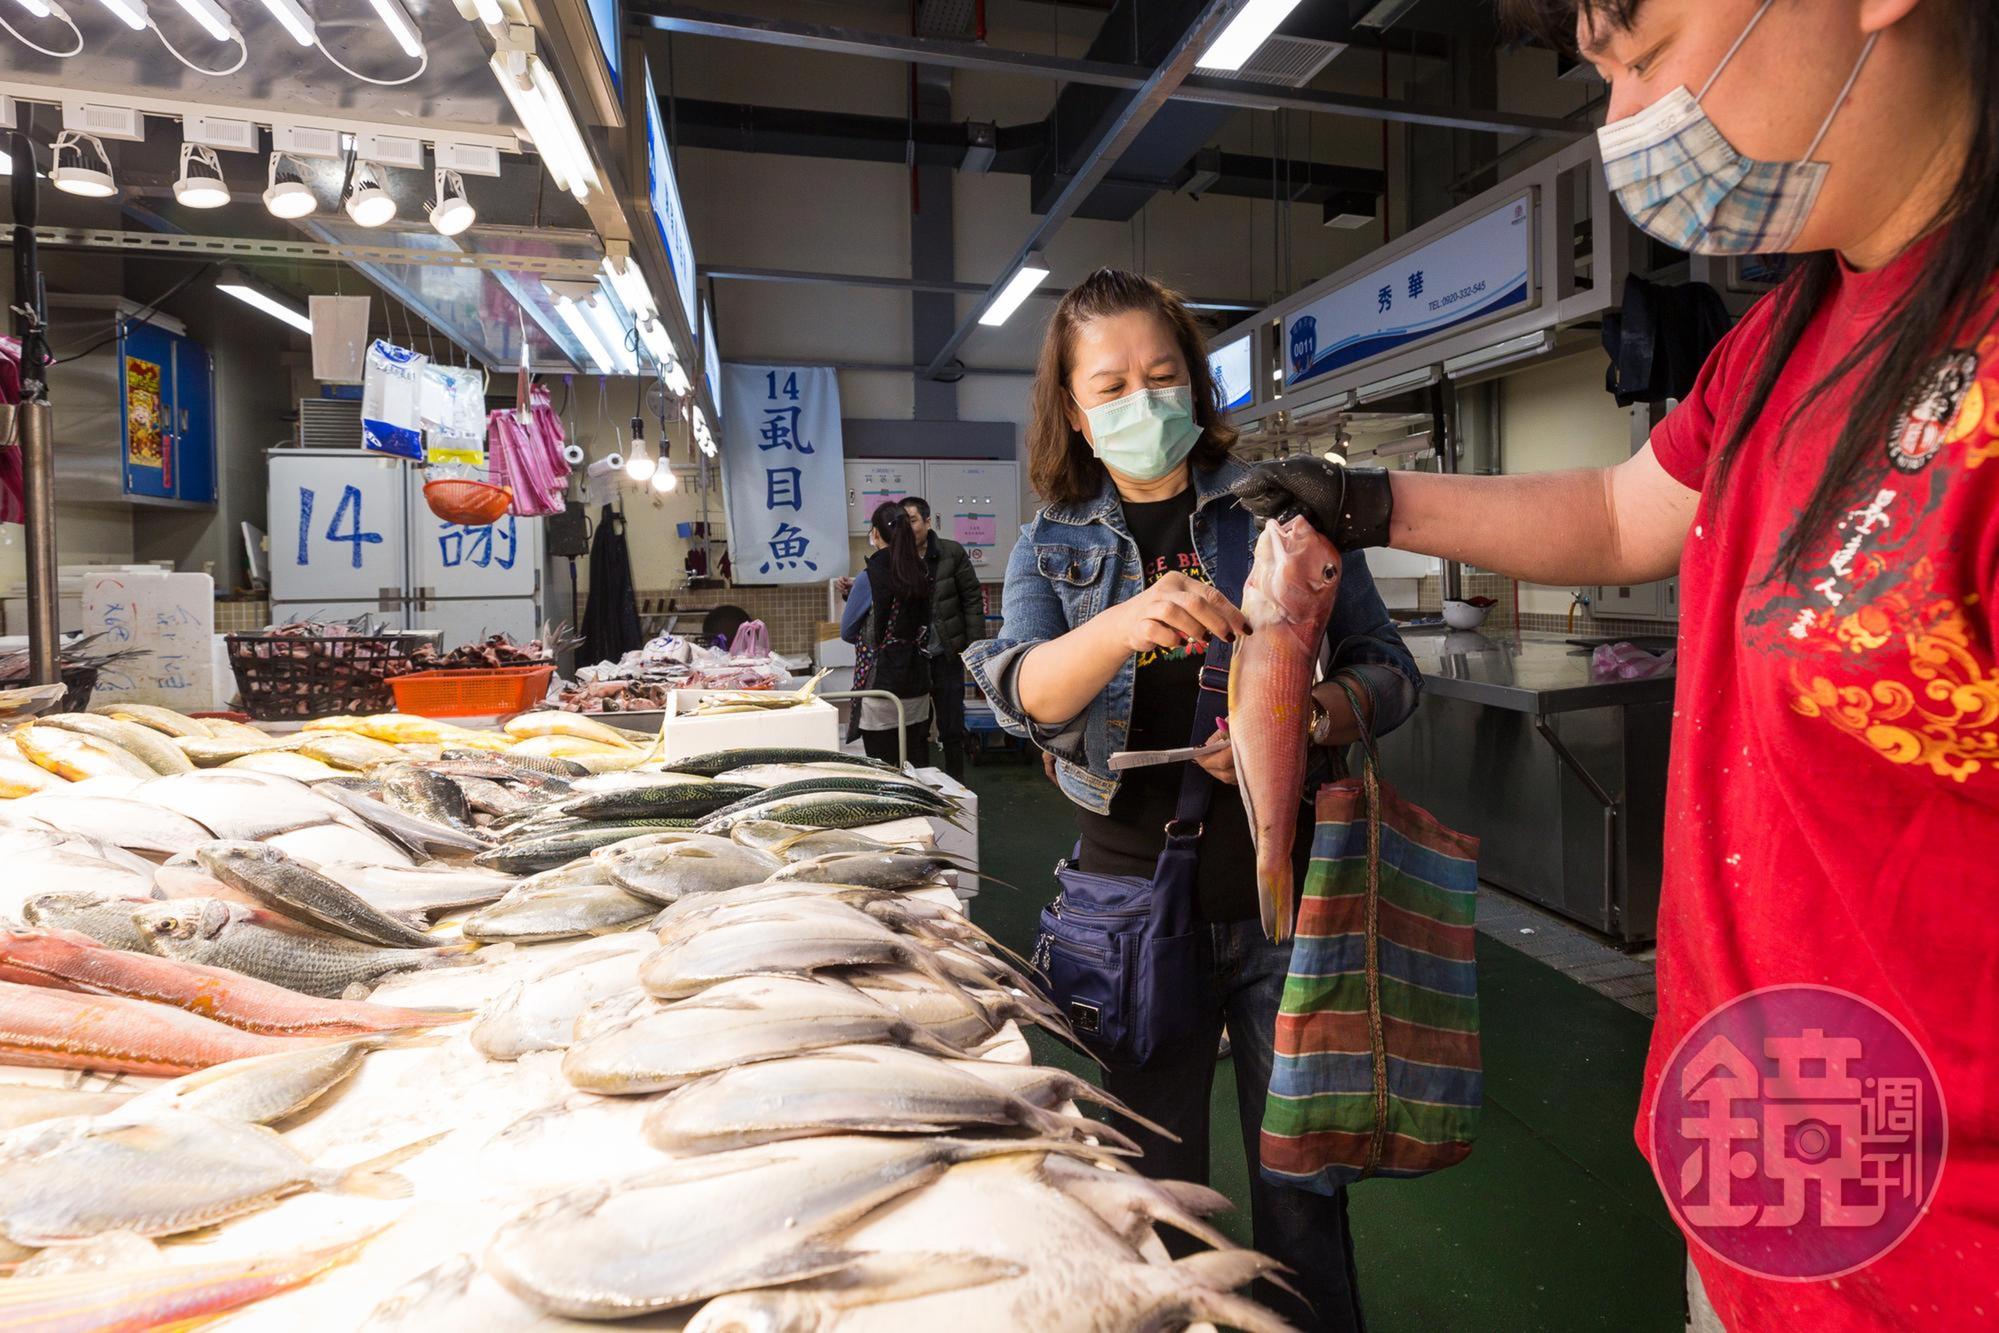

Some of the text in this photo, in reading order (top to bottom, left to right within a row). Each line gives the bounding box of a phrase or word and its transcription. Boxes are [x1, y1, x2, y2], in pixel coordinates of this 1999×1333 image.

[1377, 270, 1424, 315] 秀華
[1293, 336, 1313, 358] 0011
[758, 370, 818, 575] 14 虱目魚
[296, 484, 384, 570] 14
